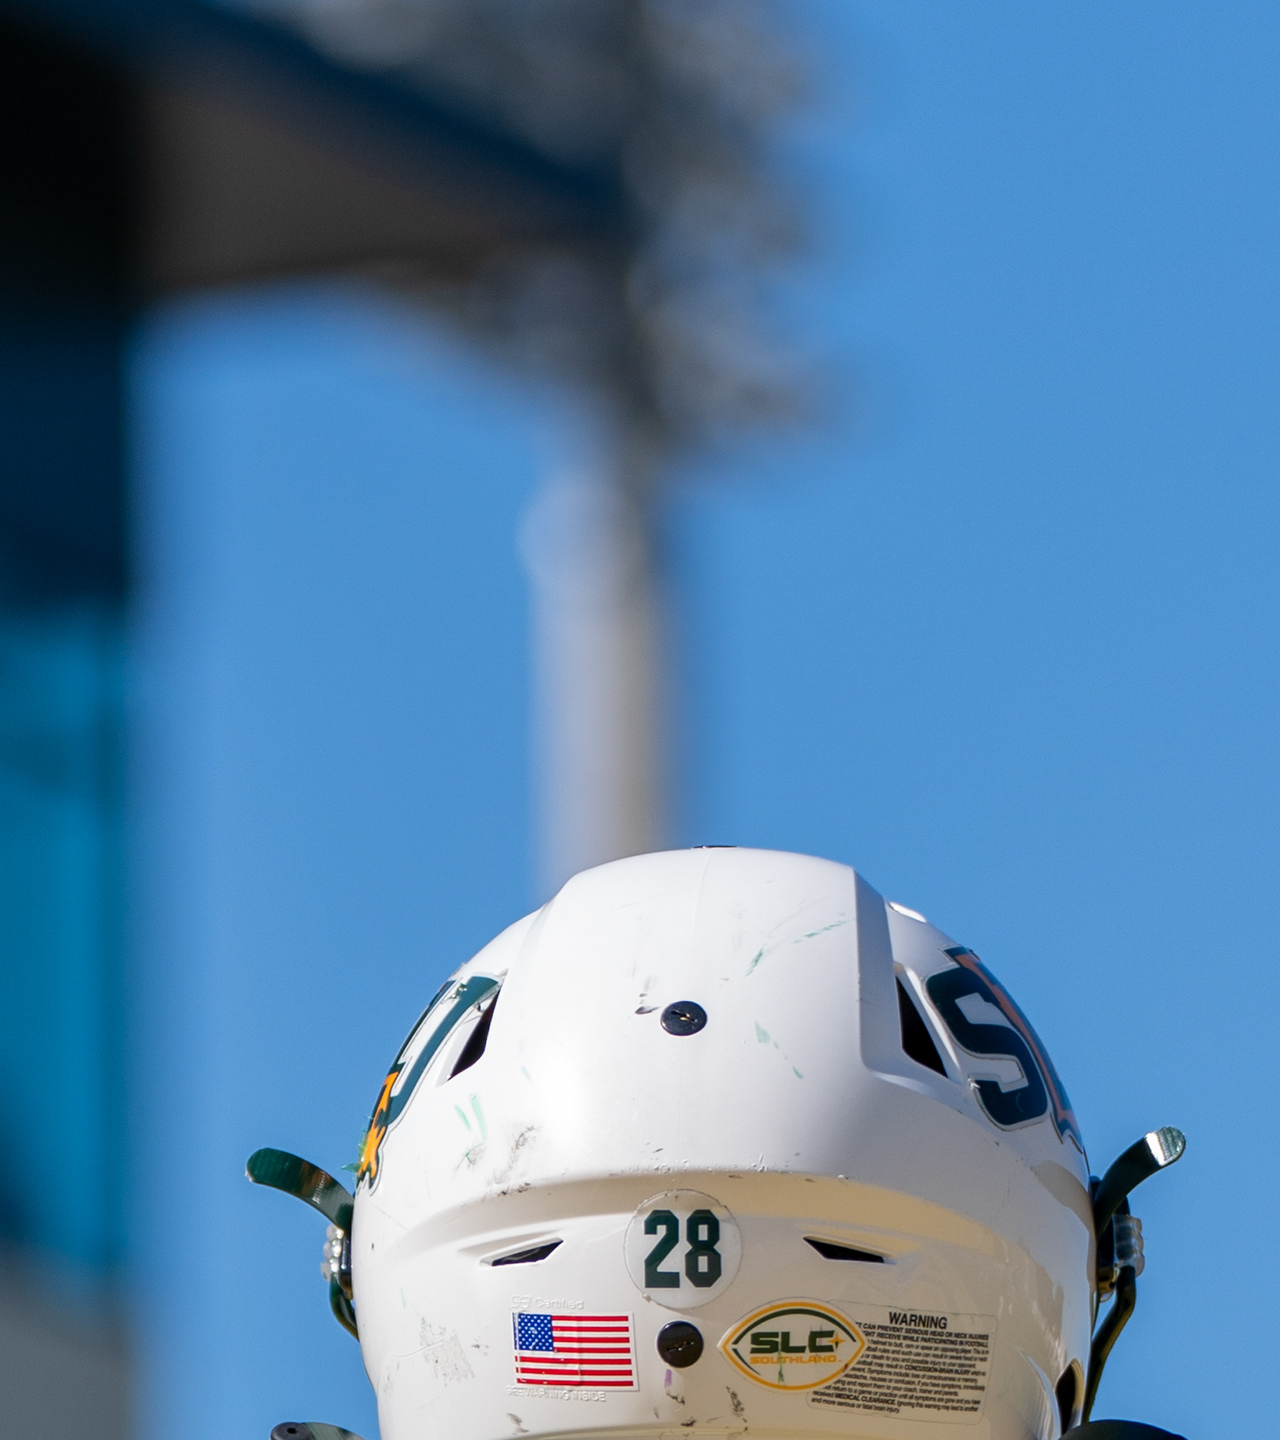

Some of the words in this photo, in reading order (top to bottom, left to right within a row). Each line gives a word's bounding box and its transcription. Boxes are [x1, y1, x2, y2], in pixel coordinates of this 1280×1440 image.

[643, 1208, 722, 1289] 28
[889, 1312, 947, 1330] WARNING
[877, 1324, 903, 1332] PREVENT
[905, 1327, 928, 1335] SERIOUS
[929, 1329, 943, 1337] HEAD
[750, 1330, 835, 1354] SLC
[750, 1355, 836, 1365] SOUTHLAND
